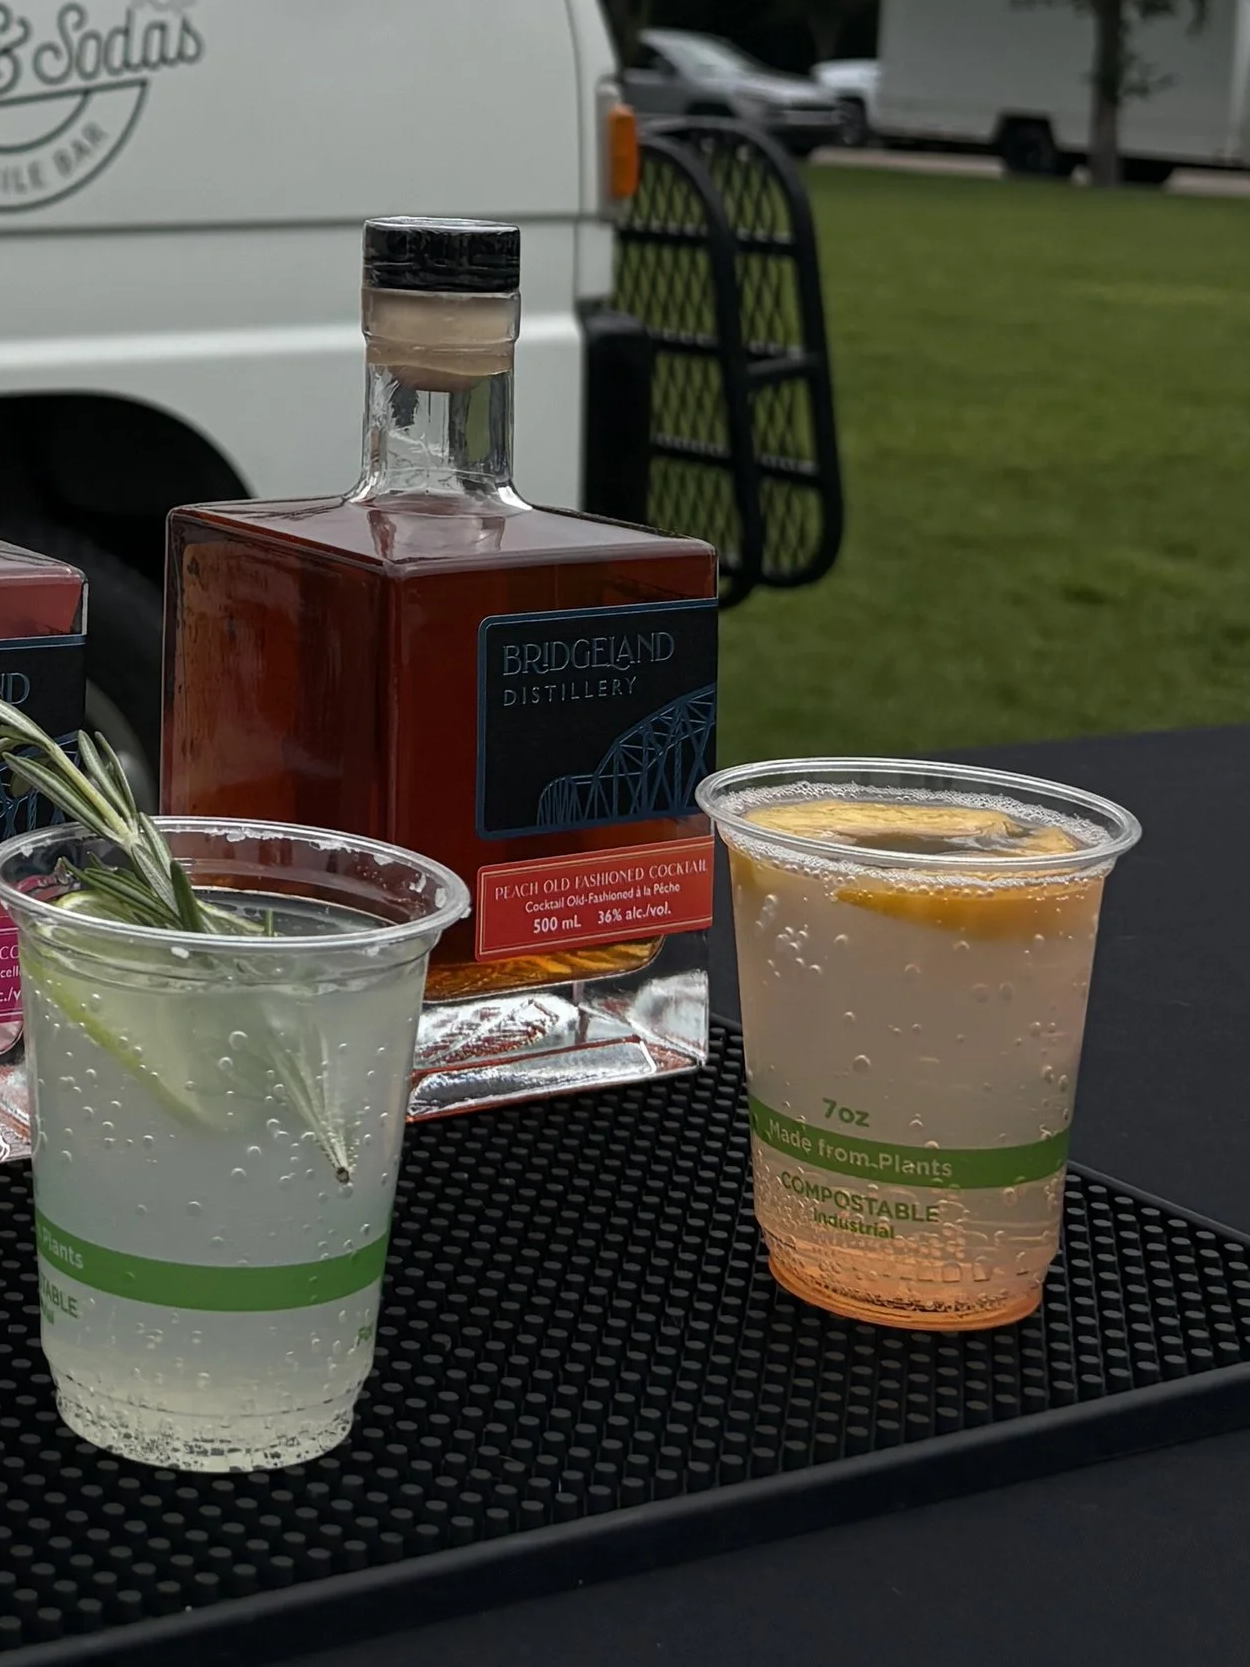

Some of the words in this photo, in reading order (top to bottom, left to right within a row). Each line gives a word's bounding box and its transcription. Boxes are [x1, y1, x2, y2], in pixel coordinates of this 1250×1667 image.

[32, 2, 205, 85] Sodas
[53, 121, 108, 176] BAR
[502, 632, 676, 676] BRIDGELAND
[503, 676, 638, 707] DISTILLERY
[494, 881, 538, 901] PEACH
[543, 877, 570, 894] OLD
[575, 866, 644, 890] FASHIONED
[648, 858, 708, 879] COCKTAIL
[525, 897, 564, 914] Cocktail
[567, 886, 634, 907] Old-Fashioned
[643, 884, 651, 897] la
[532, 917, 558, 934] 500
[561, 914, 582, 929] mL
[597, 907, 622, 925] 36%
[625, 900, 671, 920] alc./vol.
[821, 1096, 871, 1129] 7oz
[768, 1117, 813, 1153] Made
[817, 1139, 871, 1168] from
[878, 1148, 953, 1177] Plants
[780, 1171, 940, 1223] COMPOSTABLE
[813, 1208, 896, 1239] Industrial
